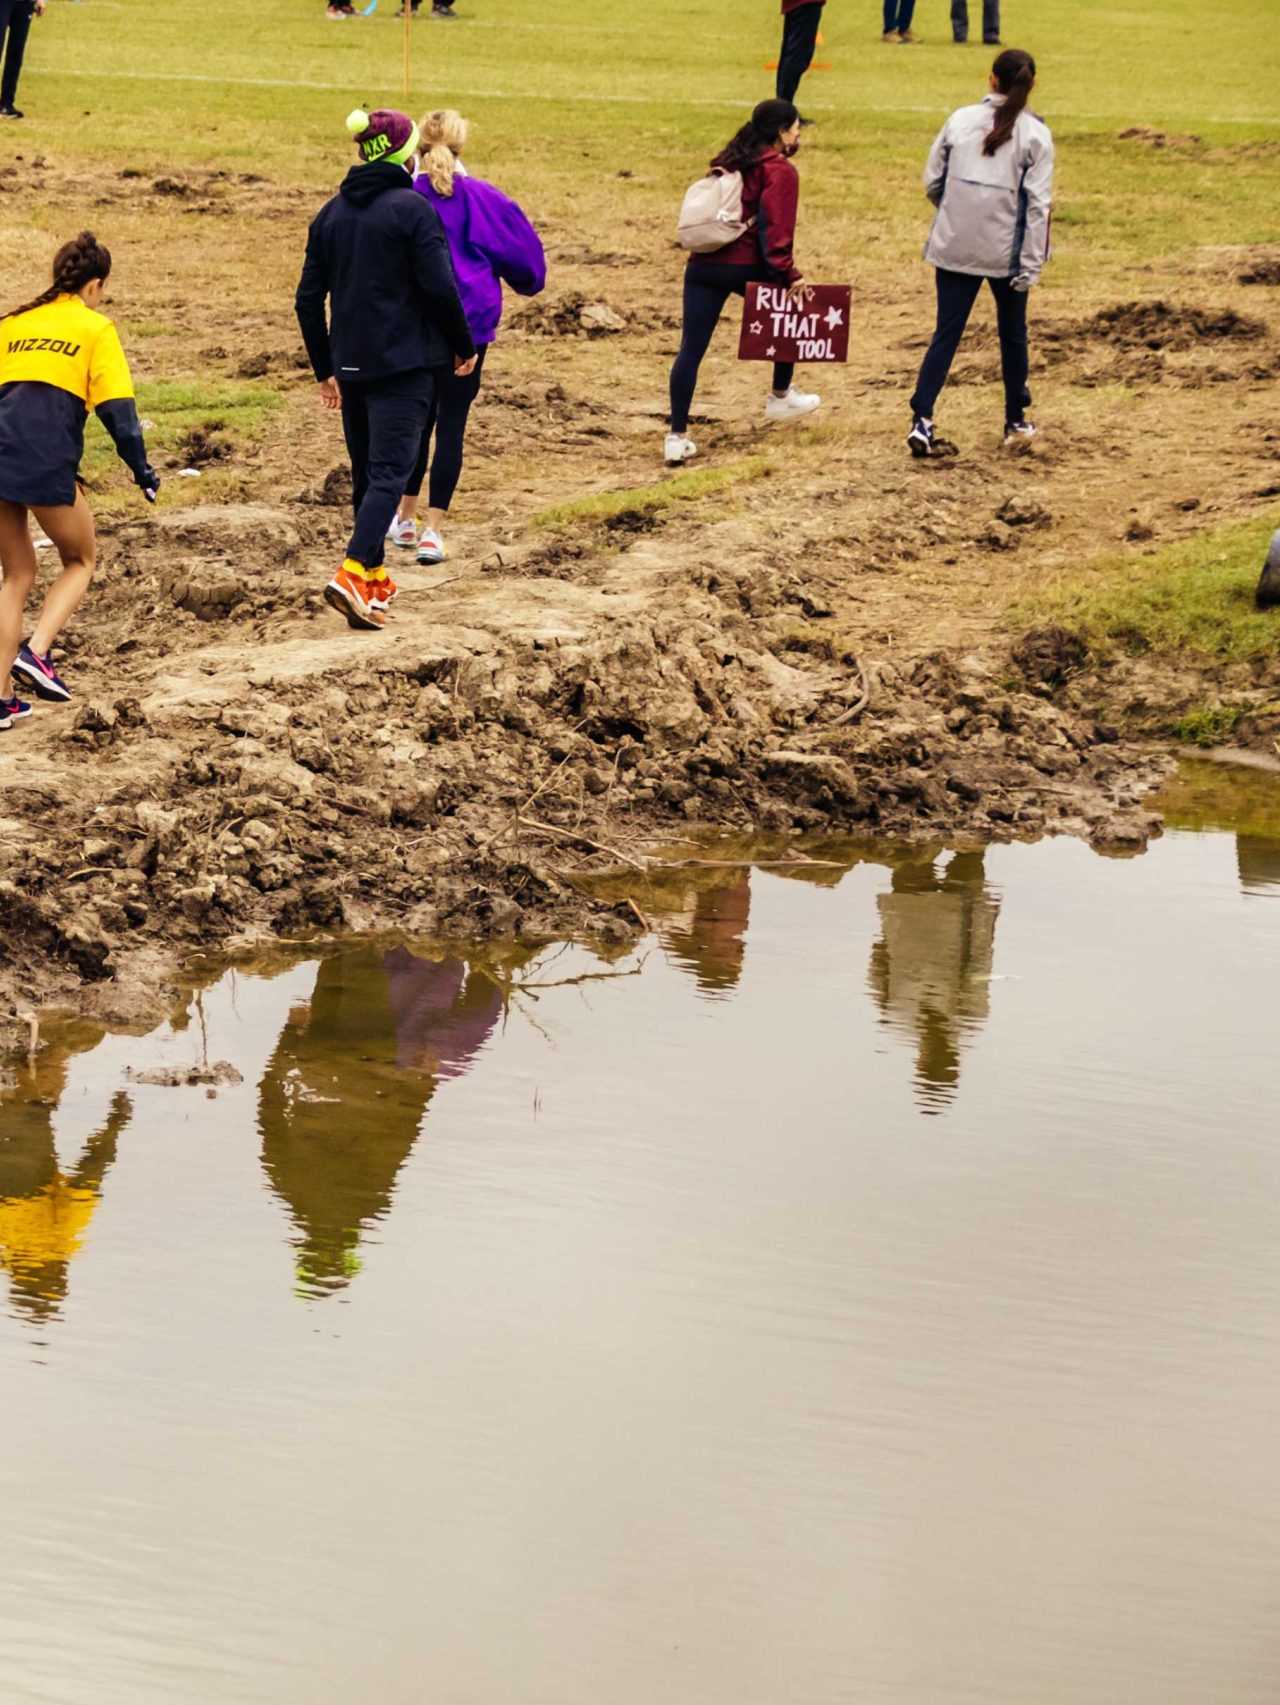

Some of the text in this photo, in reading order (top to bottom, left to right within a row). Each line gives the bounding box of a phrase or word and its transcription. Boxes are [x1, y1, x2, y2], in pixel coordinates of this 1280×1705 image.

[770, 312, 821, 338] THAT
[8, 338, 81, 357] MIZZOU
[796, 337, 835, 360] TOOL
